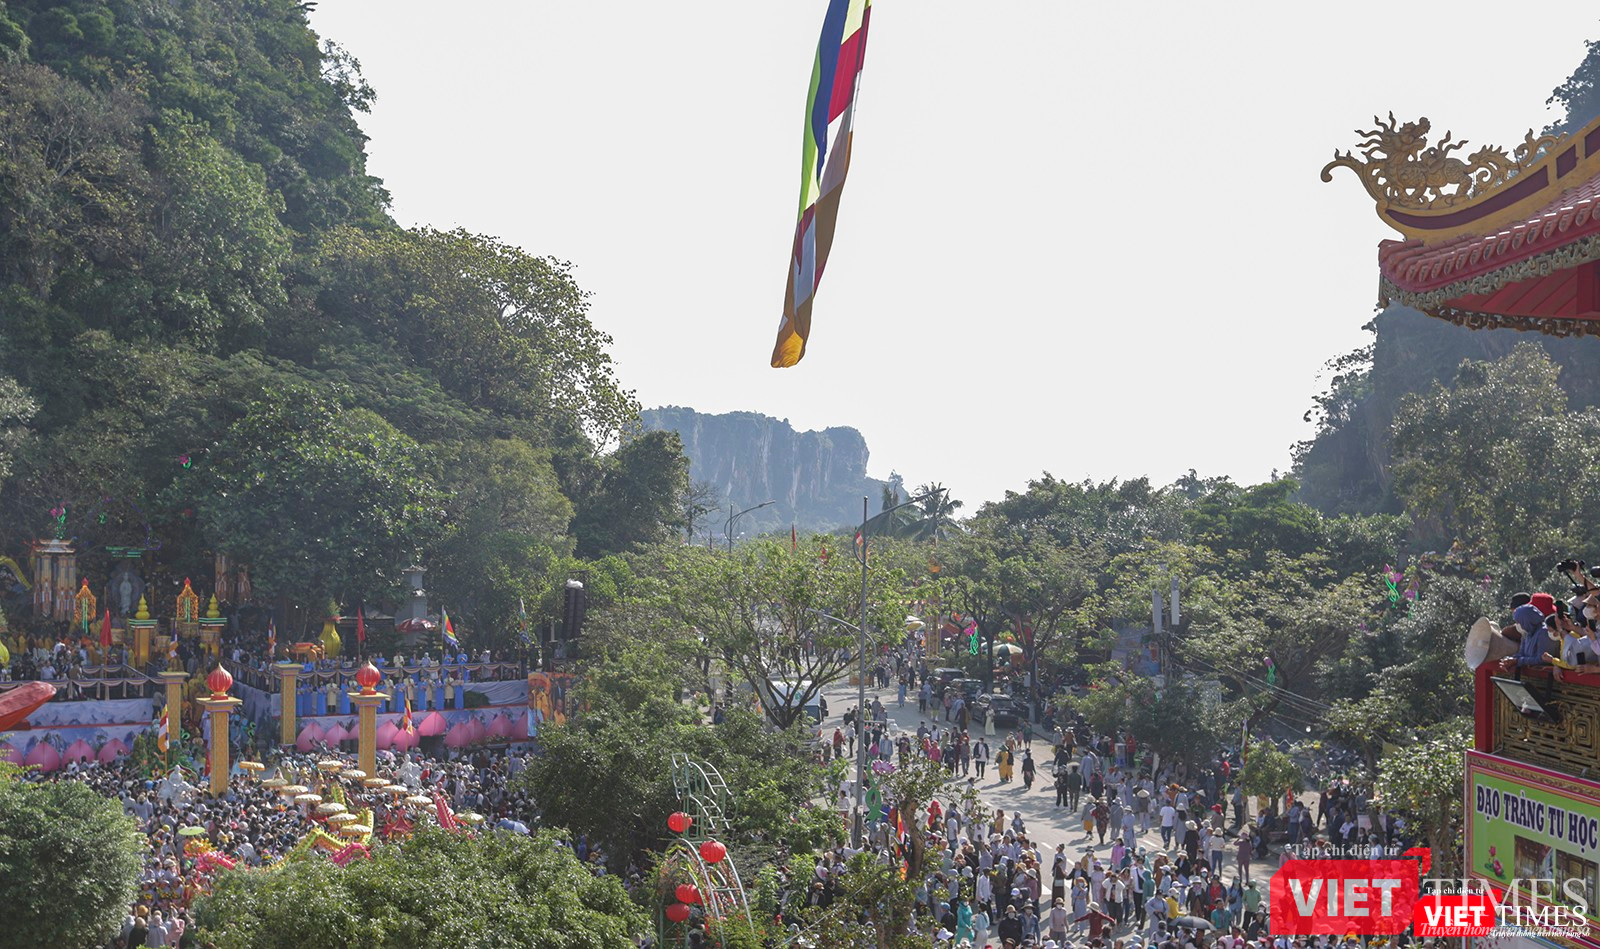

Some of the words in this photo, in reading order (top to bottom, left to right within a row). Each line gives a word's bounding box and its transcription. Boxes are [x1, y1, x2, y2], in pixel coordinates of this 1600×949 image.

[1476, 785, 1500, 821] ĐẠO
[1503, 791, 1545, 832] TRÀNG
[1547, 806, 1565, 839] TU
[1568, 812, 1598, 853] HỌC
